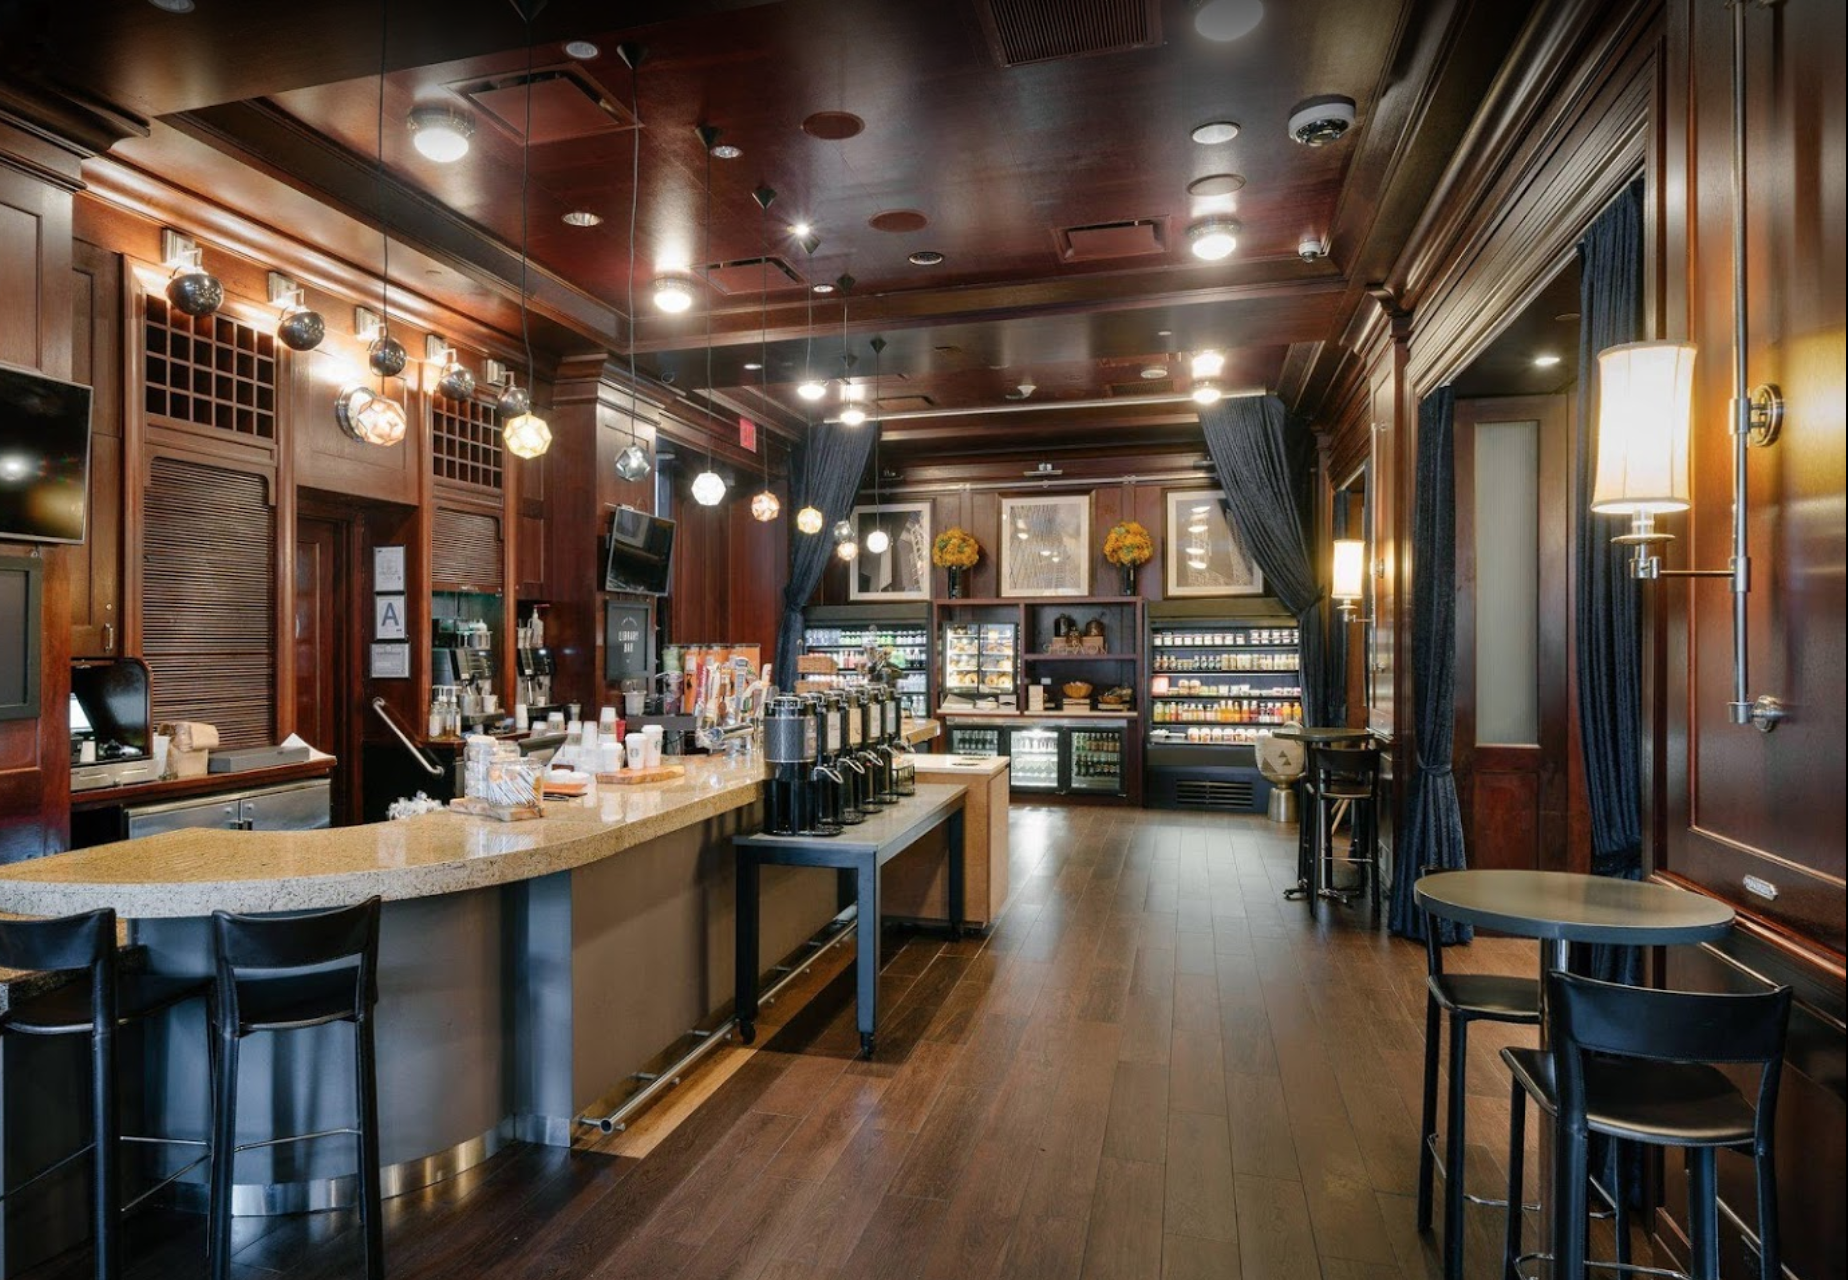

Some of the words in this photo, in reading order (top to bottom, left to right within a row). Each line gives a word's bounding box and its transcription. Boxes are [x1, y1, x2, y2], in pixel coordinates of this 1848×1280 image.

[381, 602, 400, 627] A
[618, 630, 640, 642] LIBRARY
[623, 642, 634, 654] BAR
